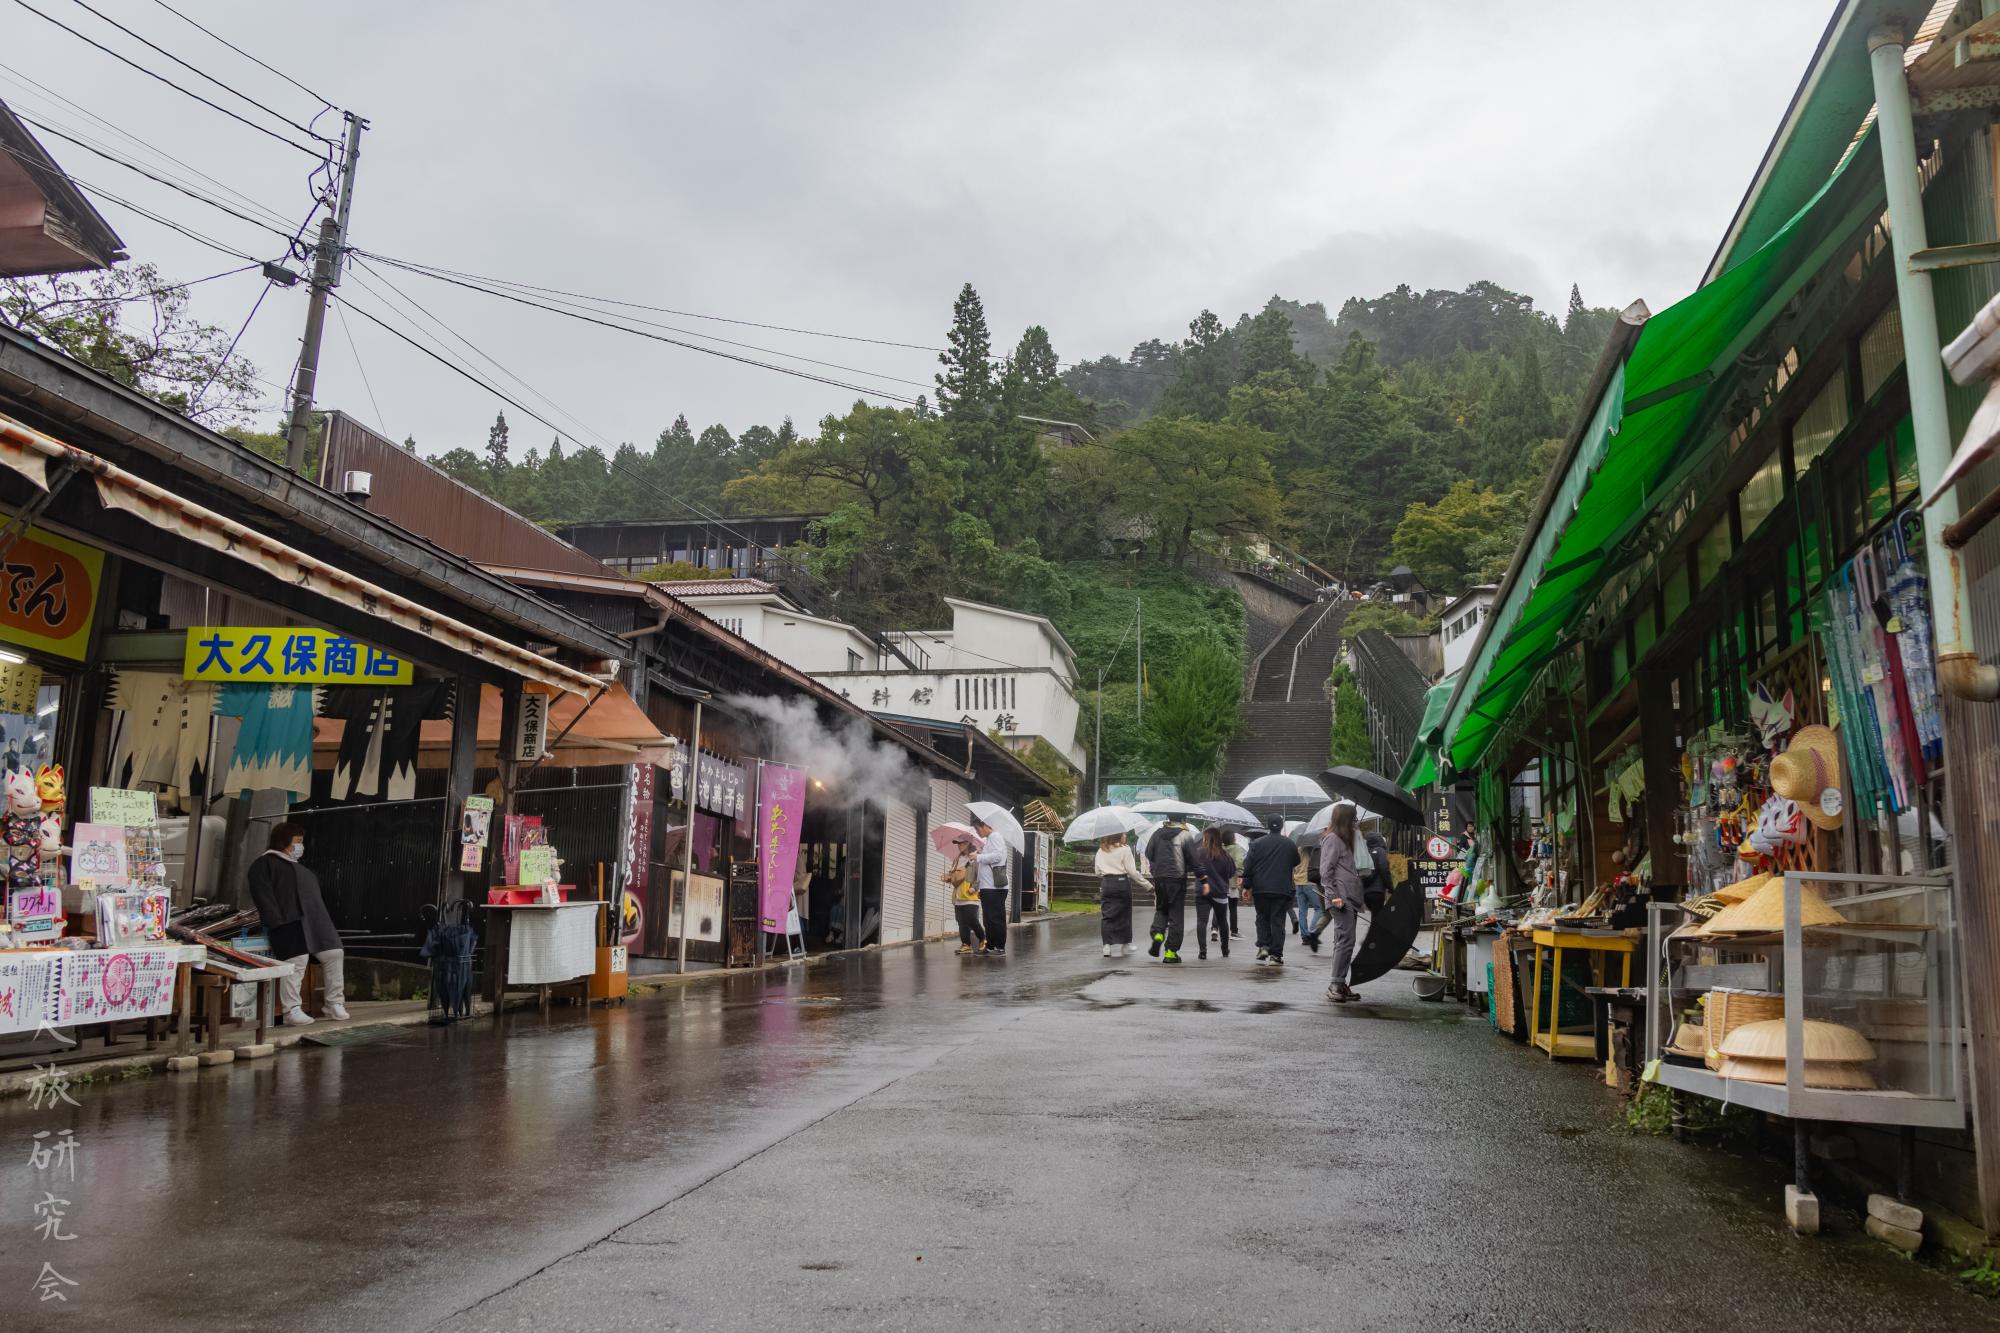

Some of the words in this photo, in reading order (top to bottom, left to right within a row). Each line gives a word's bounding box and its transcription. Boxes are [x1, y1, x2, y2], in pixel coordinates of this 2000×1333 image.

[0, 563, 68, 626] でん
[196, 633, 399, 677] 大久保商店
[522, 695, 540, 758] 大久保商店
[684, 776, 744, 812] 池菓子舗
[1438, 797, 1451, 832] 1号機
[1420, 876, 1449, 885] 山の上
